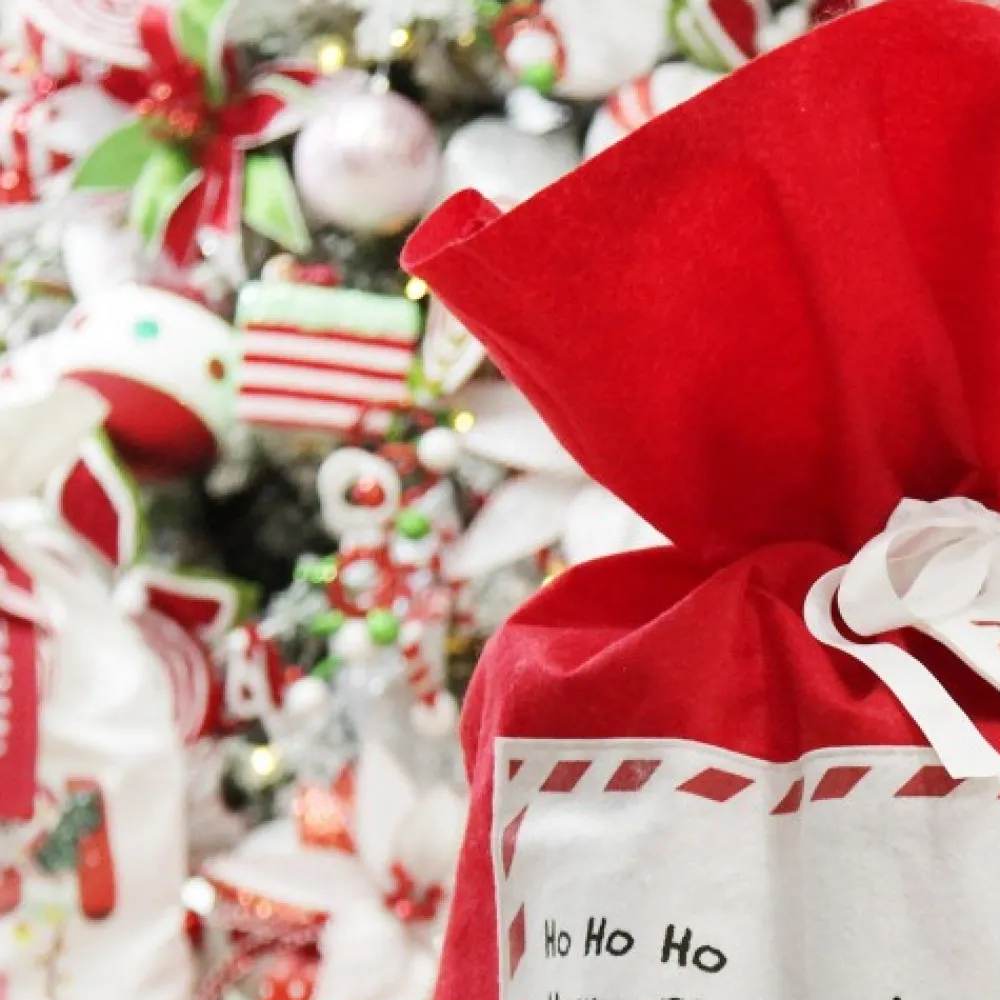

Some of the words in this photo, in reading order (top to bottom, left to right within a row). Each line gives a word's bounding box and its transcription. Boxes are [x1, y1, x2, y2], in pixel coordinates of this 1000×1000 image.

[544, 919, 572, 957] Ho
[584, 917, 635, 957] Ho
[660, 923, 727, 974] Ho
